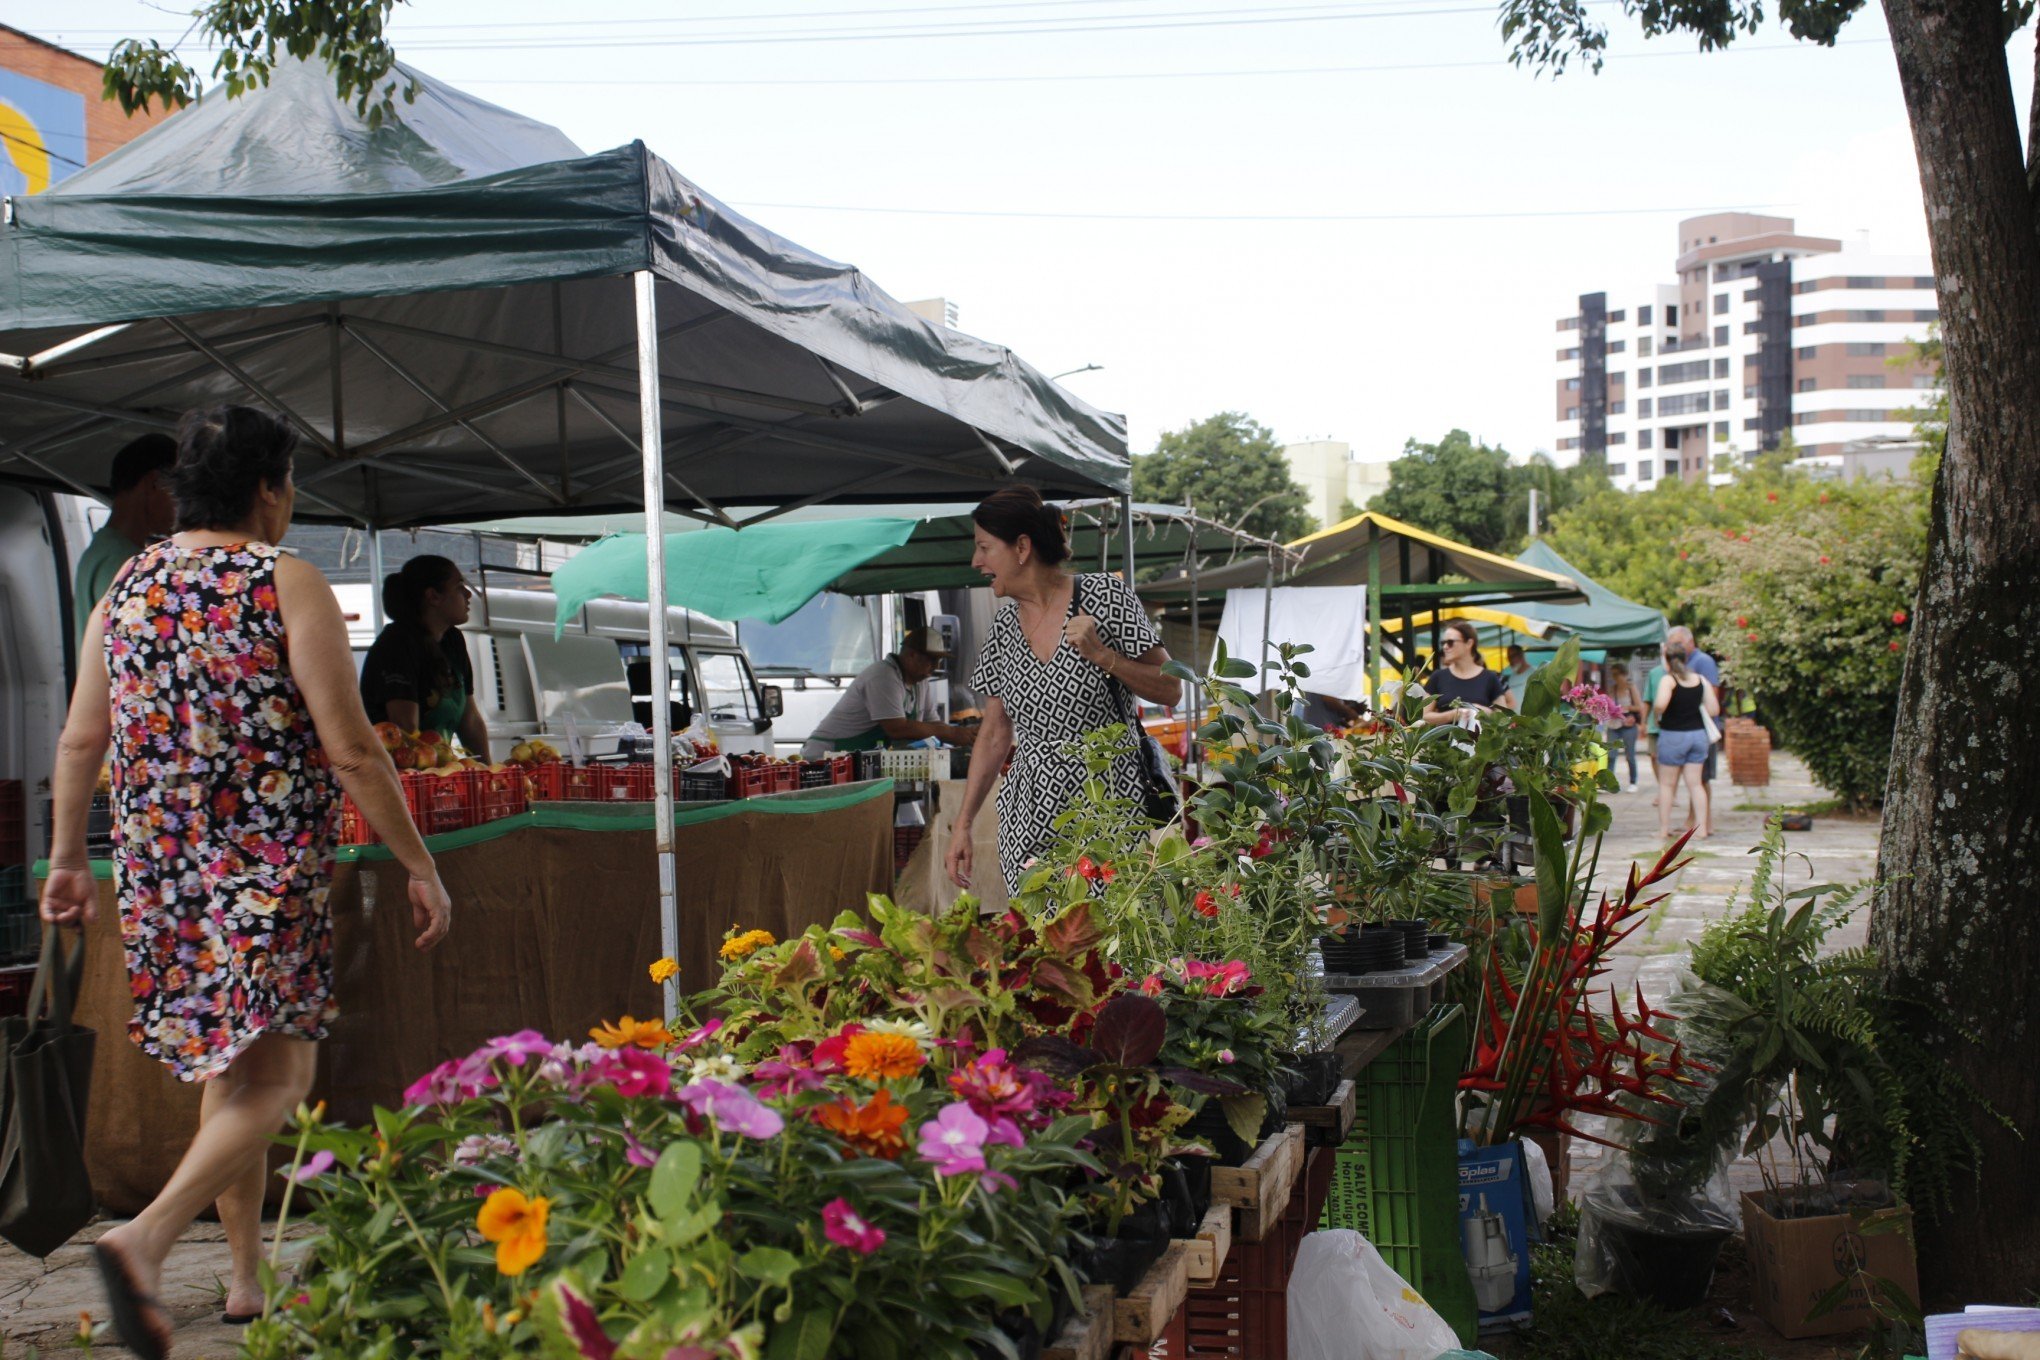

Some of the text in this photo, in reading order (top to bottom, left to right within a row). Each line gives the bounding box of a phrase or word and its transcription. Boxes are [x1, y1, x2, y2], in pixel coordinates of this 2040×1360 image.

[1342, 1161, 1354, 1230] Hortifrutigra
[1354, 1164, 1370, 1241] SALVI COME
[1458, 1165, 1496, 1181] oplas
